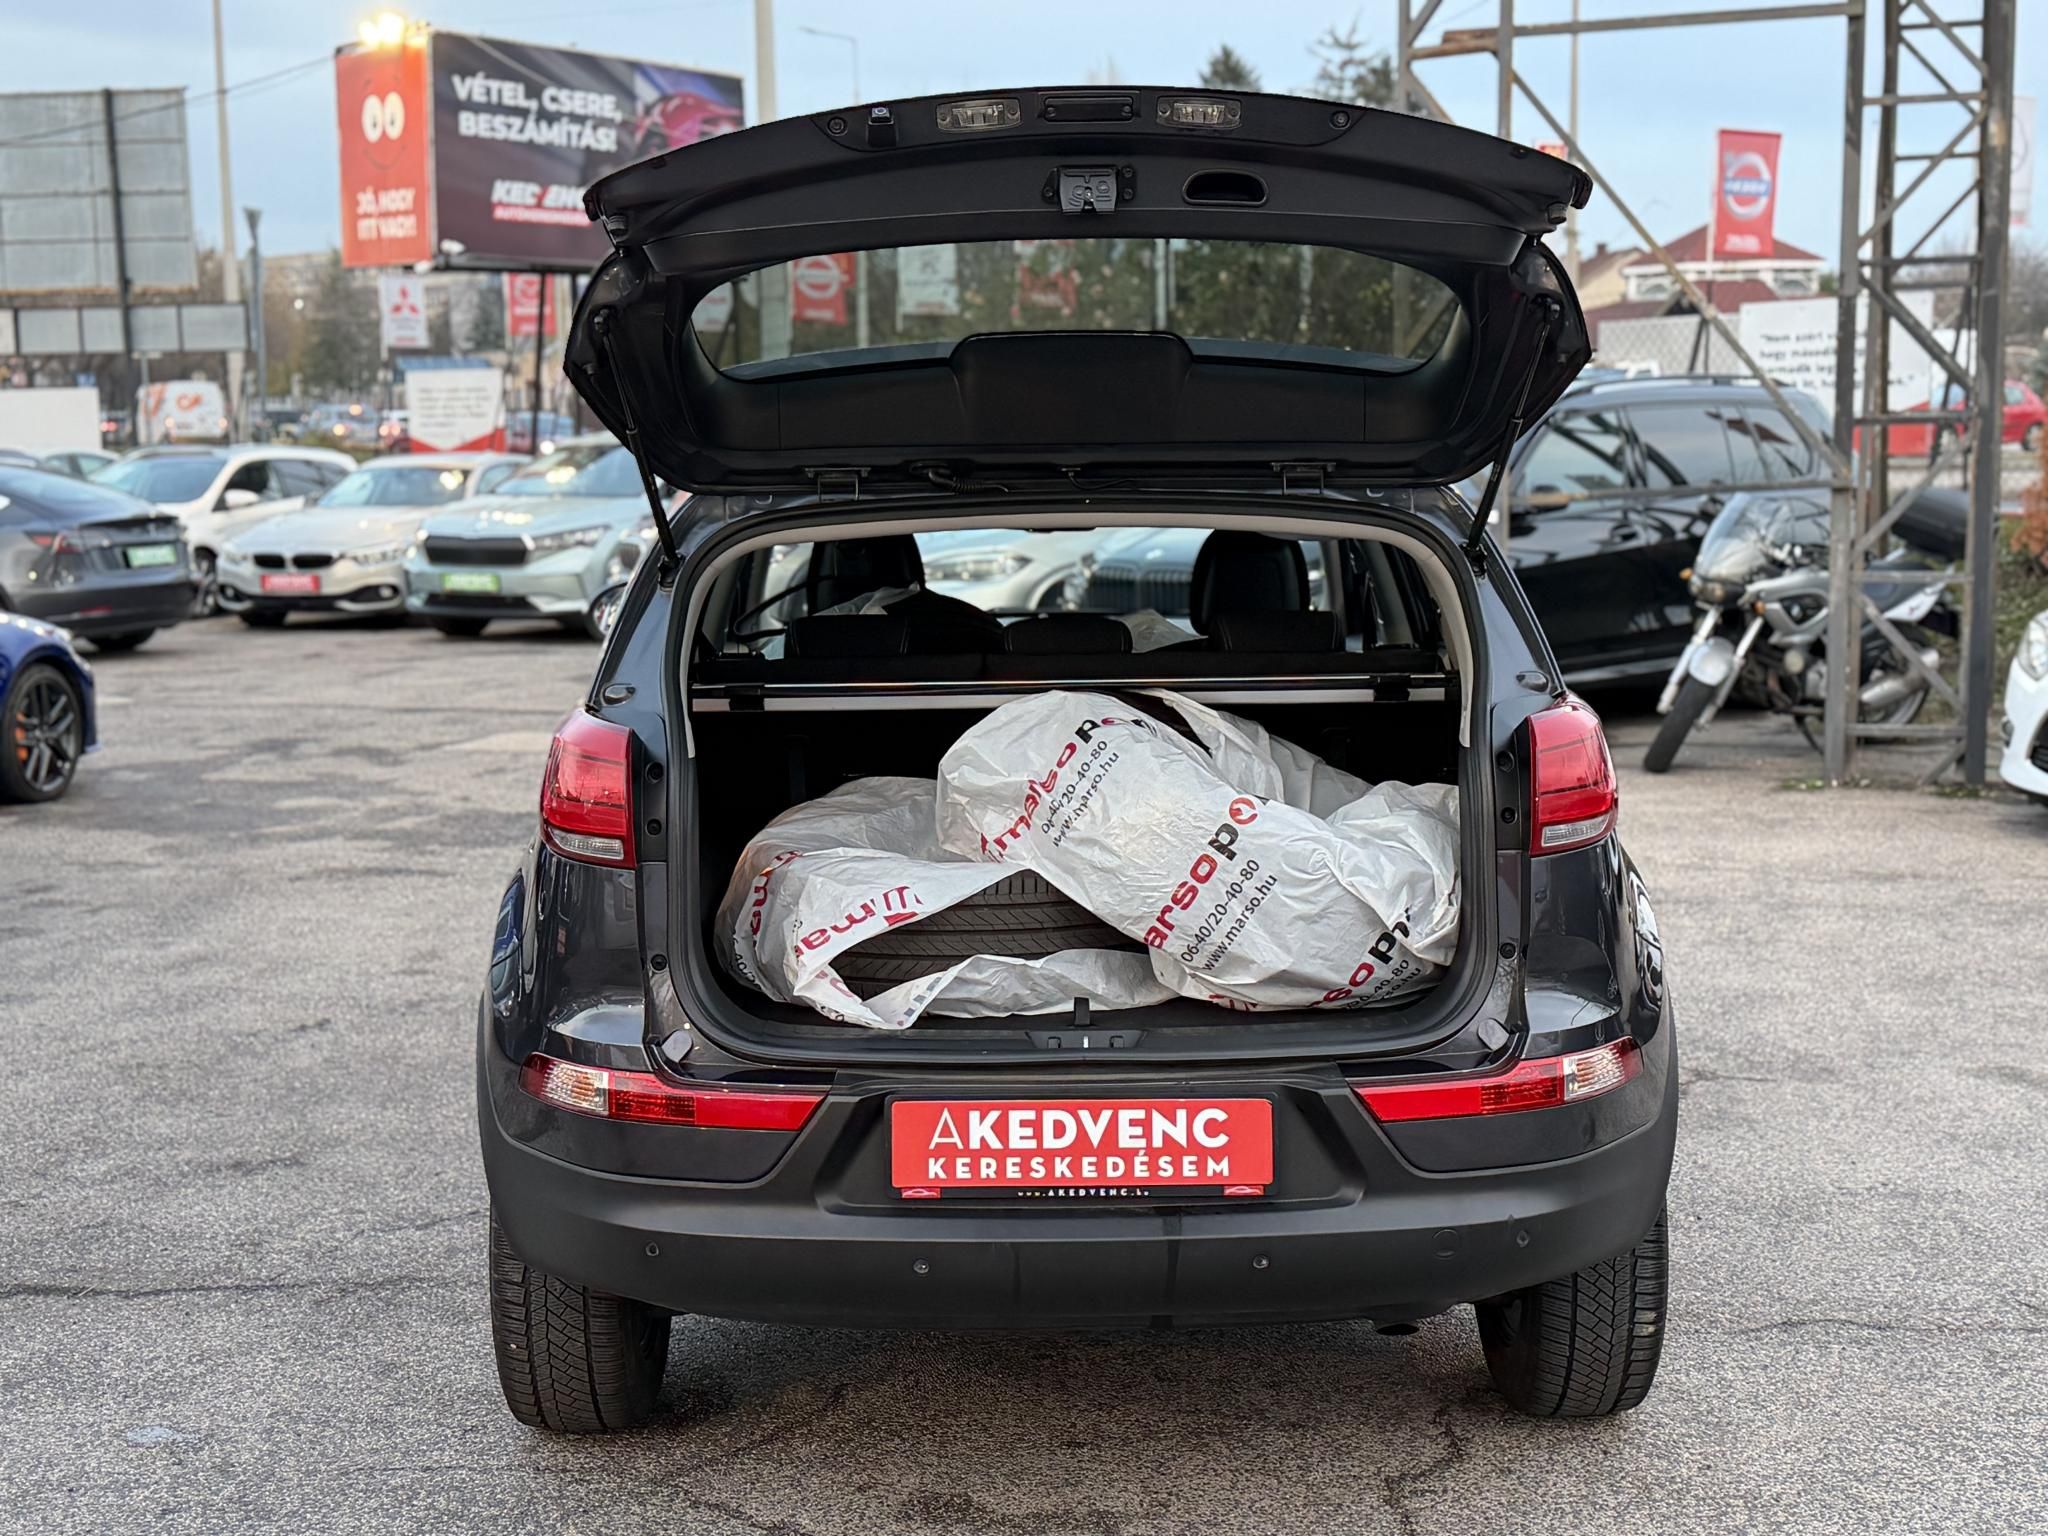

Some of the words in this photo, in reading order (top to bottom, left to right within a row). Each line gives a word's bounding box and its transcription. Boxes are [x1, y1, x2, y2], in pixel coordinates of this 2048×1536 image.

[451, 71, 539, 112] VÉTEL,
[541, 86, 623, 125] CSERE,
[457, 110, 619, 153] BESZÁMÍTÁS!
[1181, 859, 1260, 963] 06-40/20-40-80
[1203, 873, 1278, 971] www.marso.hu
[929, 1149, 1230, 1180] KERESKEDÉSEM
